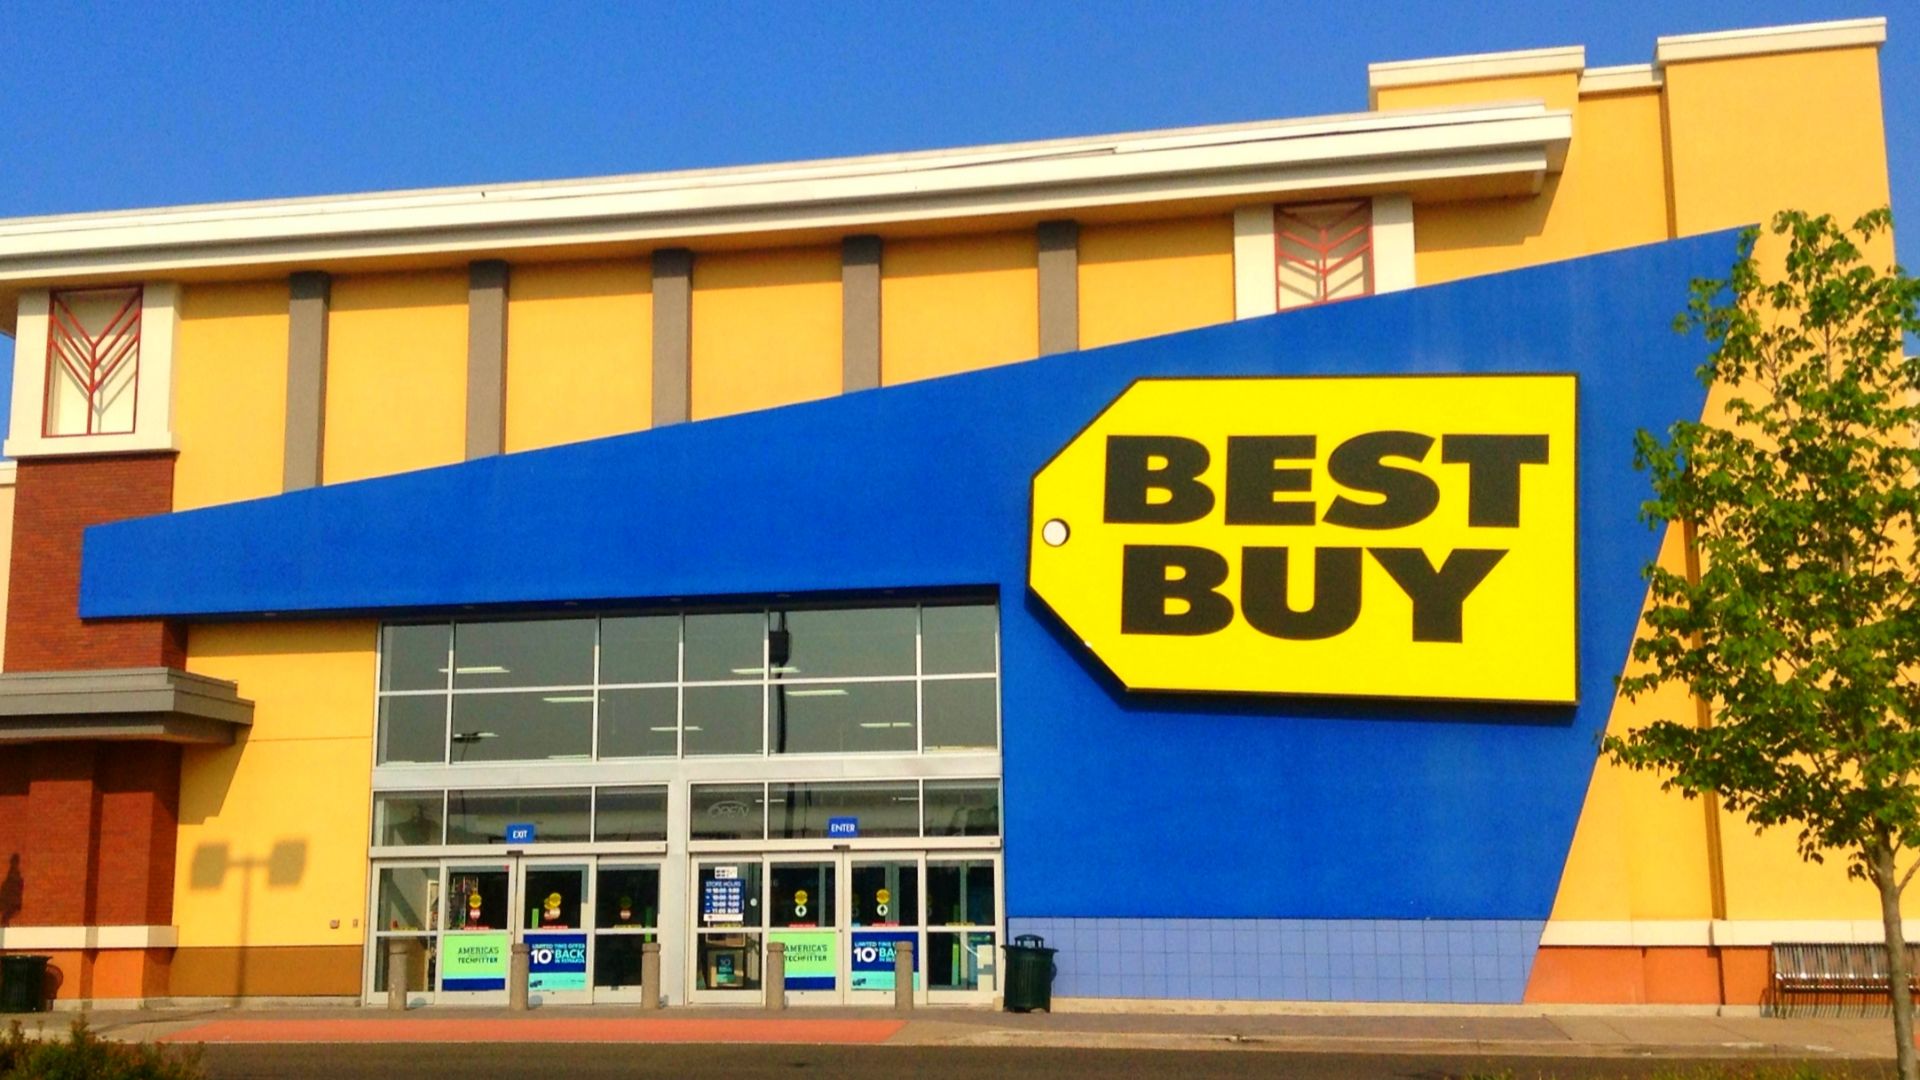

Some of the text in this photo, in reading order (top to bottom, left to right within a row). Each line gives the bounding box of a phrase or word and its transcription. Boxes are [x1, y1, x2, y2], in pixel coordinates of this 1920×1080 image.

[1103, 430, 1549, 530] BEST
[1120, 544, 1510, 643] BUY
[831, 823, 855, 832] ENTER
[512, 830, 528, 839] EXIT
[555, 949, 585, 960] BACK
